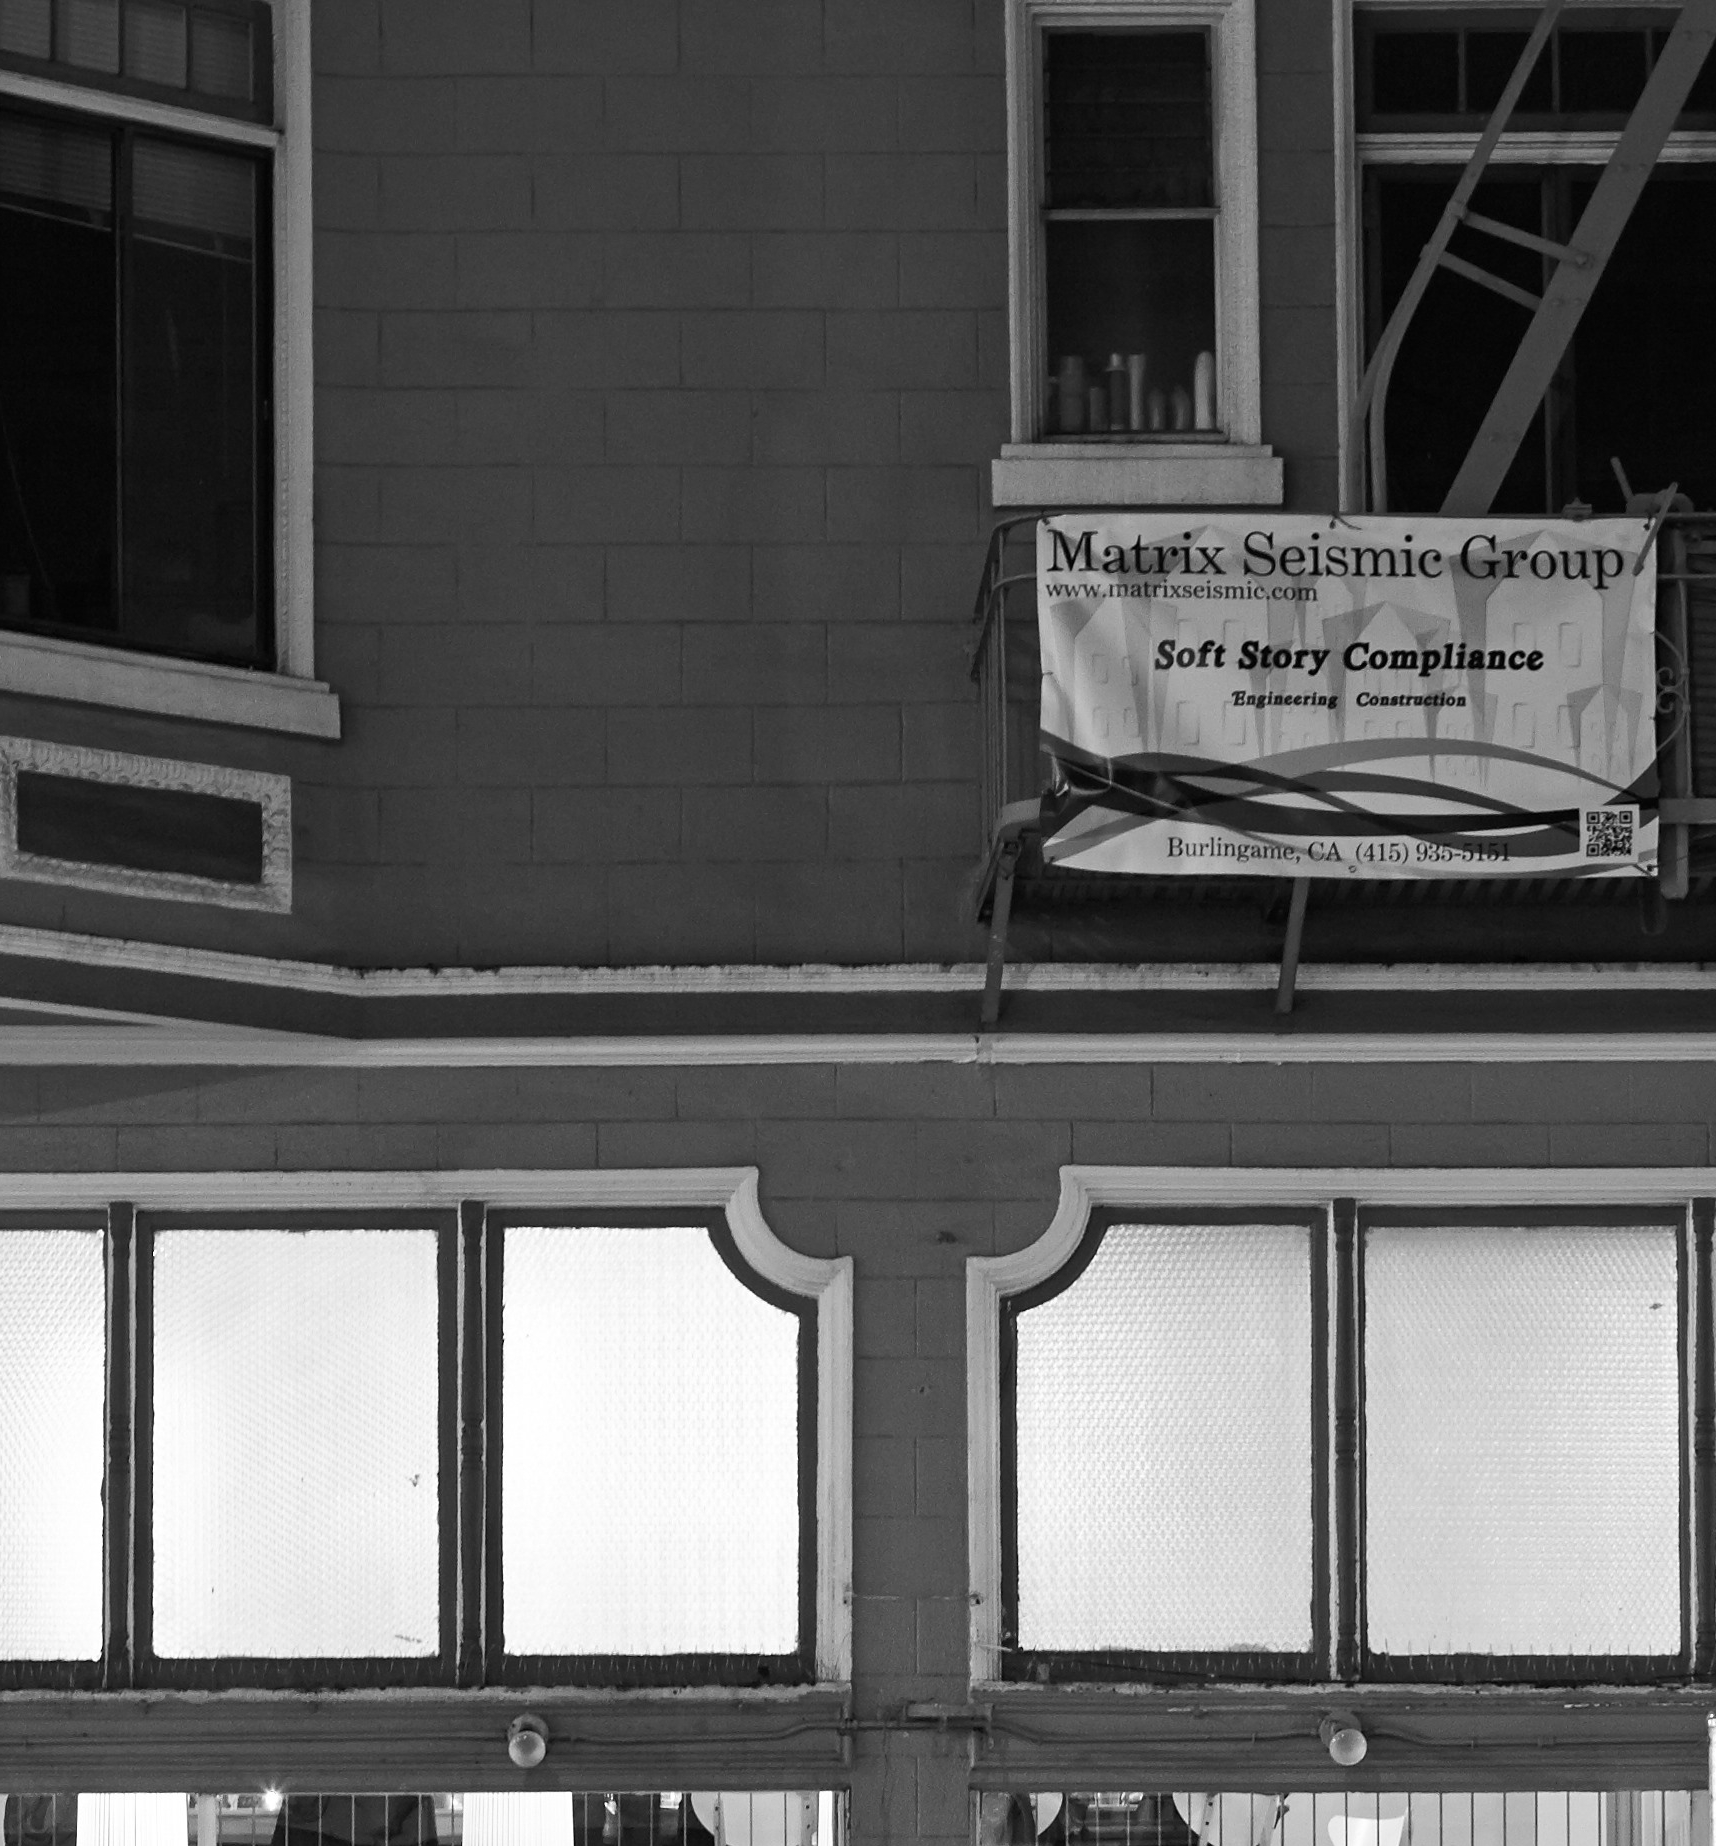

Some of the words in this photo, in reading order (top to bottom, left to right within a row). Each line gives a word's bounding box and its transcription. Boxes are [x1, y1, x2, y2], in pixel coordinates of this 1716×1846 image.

[1046, 528, 1227, 575] Matrix
[1243, 530, 1442, 579] Seismic
[1460, 534, 1624, 588] Group
[1045, 579, 1318, 602] www.matrixseismic.com
[1155, 640, 1226, 670] Soft
[1238, 642, 1330, 676] Story
[1343, 643, 1544, 674] Compliance
[1231, 690, 1338, 709] Engineering
[1356, 691, 1467, 708] Construction
[1167, 836, 1301, 863] Burlingame,
[1307, 841, 1342, 862] CA
[1355, 842, 1410, 865] (415)
[1415, 843, 1511, 863] 935-5151
